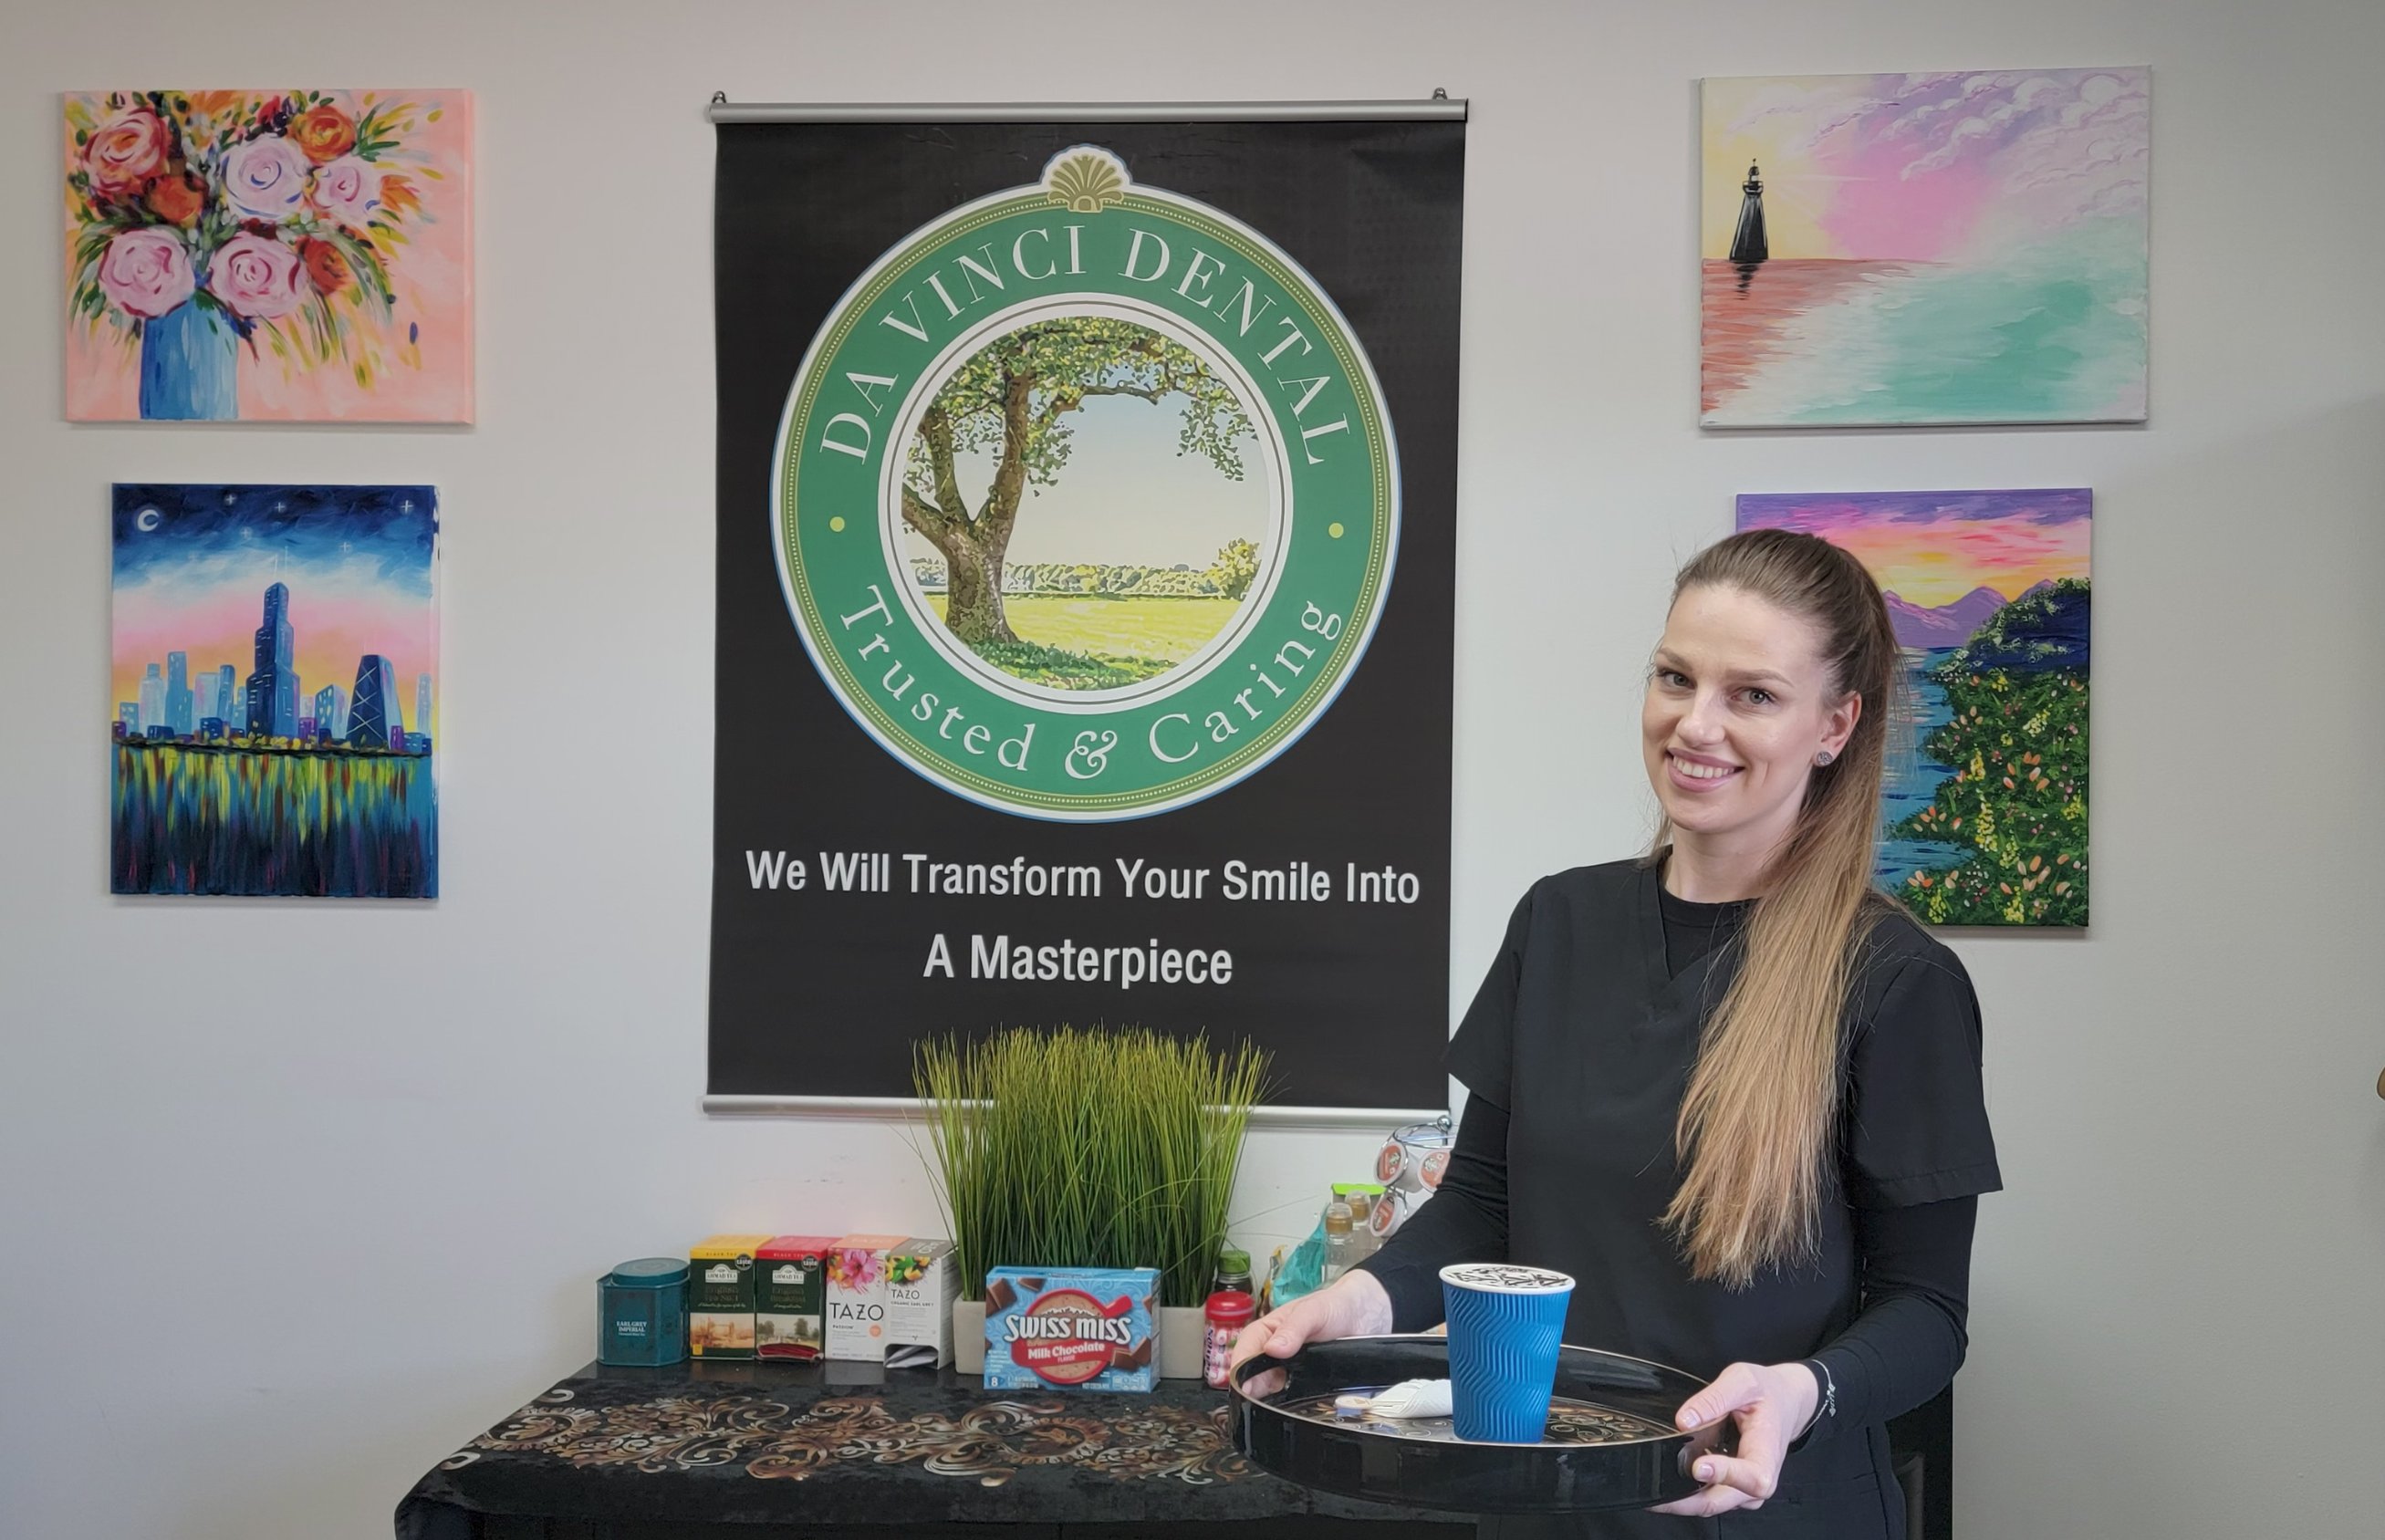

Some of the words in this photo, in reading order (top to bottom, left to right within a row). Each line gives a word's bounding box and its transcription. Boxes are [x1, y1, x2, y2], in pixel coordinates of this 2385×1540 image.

[820, 372, 899, 465] DA
[879, 225, 1088, 342] VINCI
[1118, 228, 1350, 466] DENTAL
[840, 584, 1036, 772] Trusted
[1064, 730, 1119, 780] &
[1149, 600, 1343, 765] Caring
[745, 849, 807, 890] We
[820, 852, 890, 892] Will
[902, 854, 1101, 897] Transform
[1116, 858, 1211, 900] Your
[1223, 860, 1331, 902] Smile
[1347, 863, 1420, 904] Into
[923, 934, 955, 978] A
[971, 934, 1233, 990] Masterpiece
[890, 1288, 921, 1300] TAZO
[829, 1302, 884, 1321] TAZO
[1004, 1314, 1071, 1342] SWISS
[1027, 1348, 1051, 1359] Milk
[1052, 1342, 1105, 1357] Chocolate
[991, 1377, 999, 1388] 8
